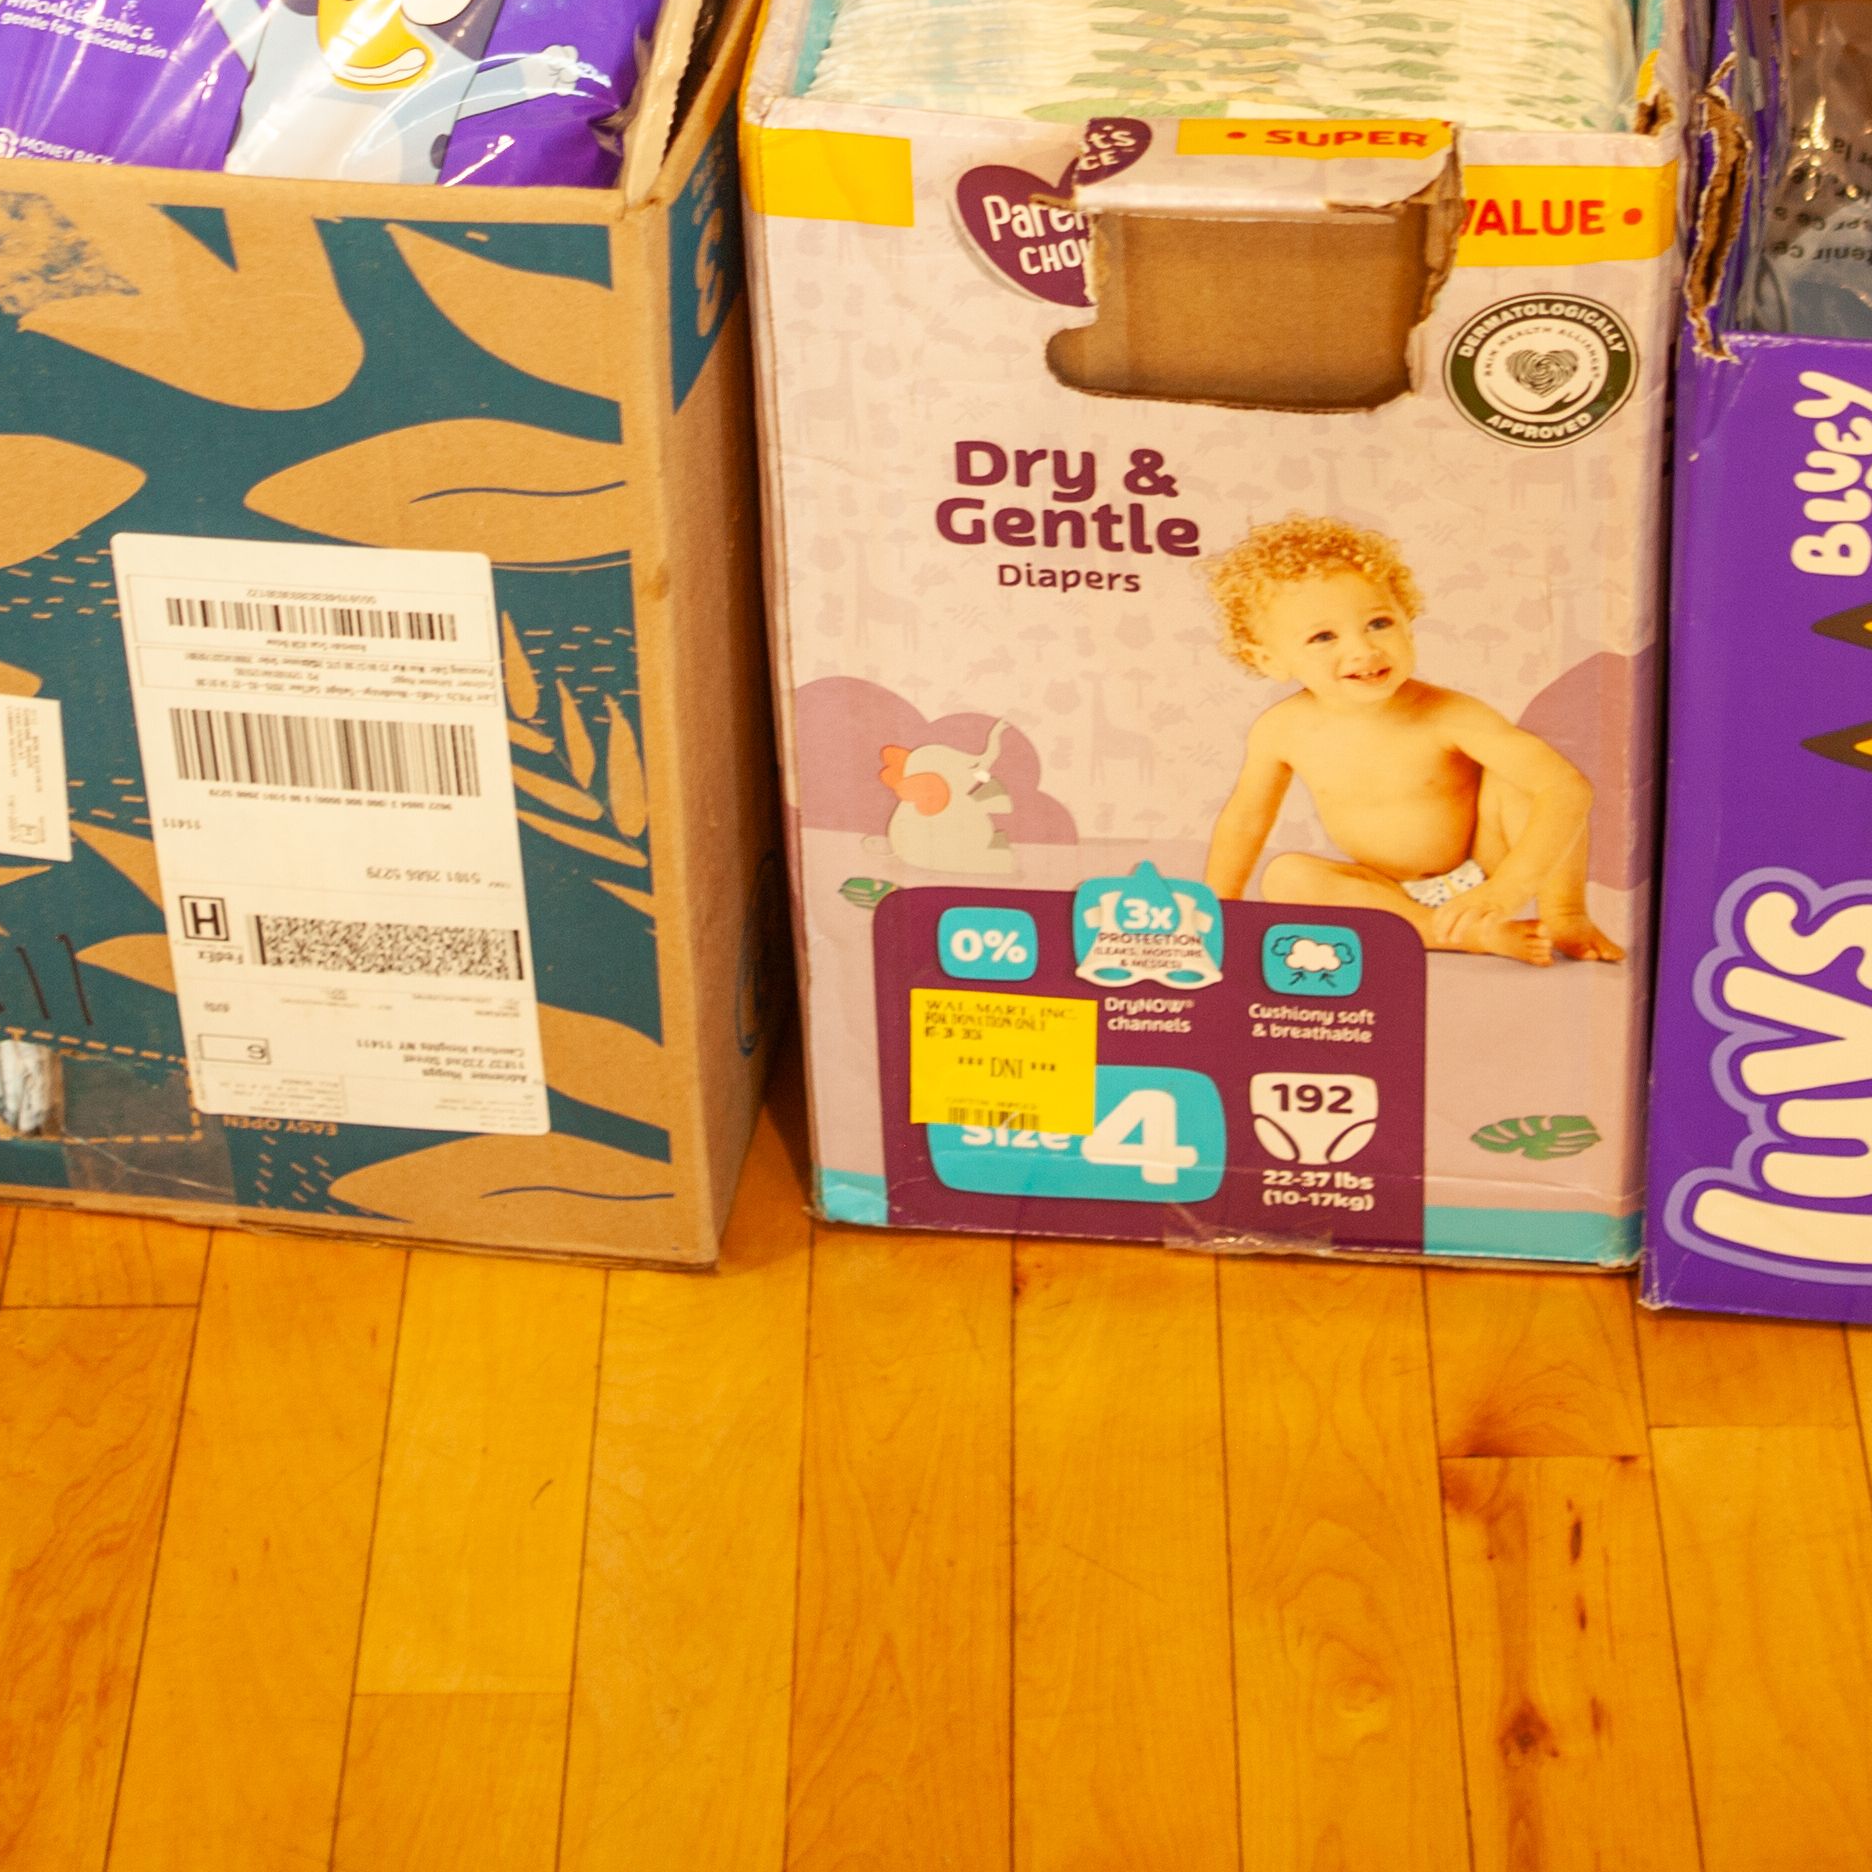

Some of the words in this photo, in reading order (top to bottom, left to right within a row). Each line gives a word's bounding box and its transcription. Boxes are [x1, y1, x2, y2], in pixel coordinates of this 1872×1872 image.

[0, 11, 51, 31] gentle
[19, 136, 74, 160] MONEY
[1266, 128, 1429, 150] SUPER
[1460, 199, 1606, 238] VALUE
[1457, 302, 1627, 359] DERMATOLOGICALLY
[1485, 412, 1593, 440] APPROVED
[956, 439, 1097, 505] Dry
[1122, 446, 1181, 497] &
[934, 497, 1202, 558] Gentle
[996, 562, 1142, 595] Diapers
[190, 901, 221, 936] H
[1122, 897, 1174, 931] 3x
[949, 930, 1029, 967] 0%
[1098, 931, 1202, 947] PROTECTION
[196, 950, 244, 965] FedEx
[1141, 947, 1203, 959] MOISTURE
[1106, 1015, 1192, 1034] channels
[1248, 1002, 1335, 1026] Cushiony
[1337, 1009, 1376, 1026] soft
[1251, 1022, 1268, 1038] &
[1269, 1022, 1373, 1044] breathable
[1270, 1083, 1354, 1115] 192
[222, 1114, 280, 1134] OPEN
[282, 1118, 338, 1136] EASY
[1081, 1090, 1199, 1186] 4
[1262, 1170, 1332, 1188] 22-37
[1333, 1170, 1376, 1191] lbs
[1262, 1190, 1376, 1213] (10-17kg)
